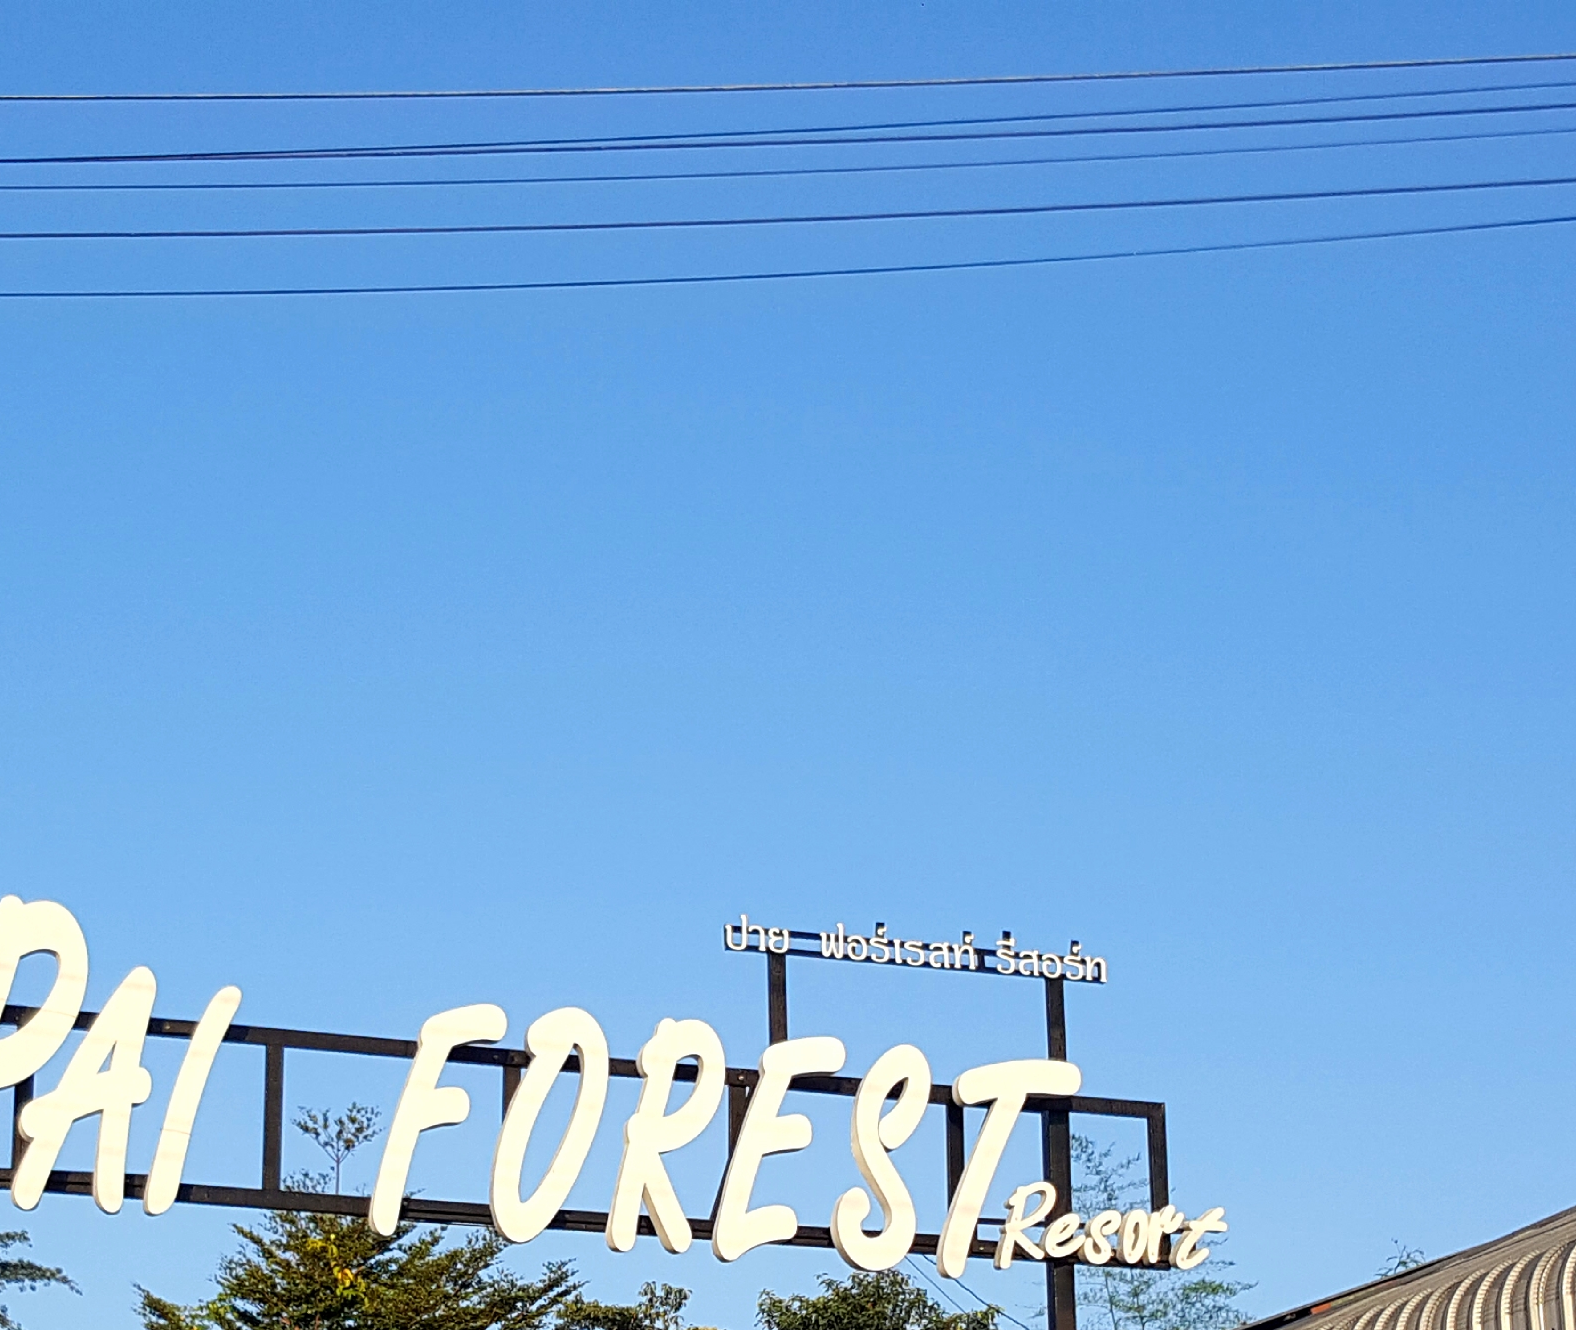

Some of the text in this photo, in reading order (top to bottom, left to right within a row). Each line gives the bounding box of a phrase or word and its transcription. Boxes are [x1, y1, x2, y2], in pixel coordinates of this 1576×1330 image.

[725, 914, 790, 955] ปาย
[996, 938, 1108, 984] รีสอร์ท
[366, 1002, 1083, 1280] FOREST
[993, 1181, 1229, 1270] Resort
